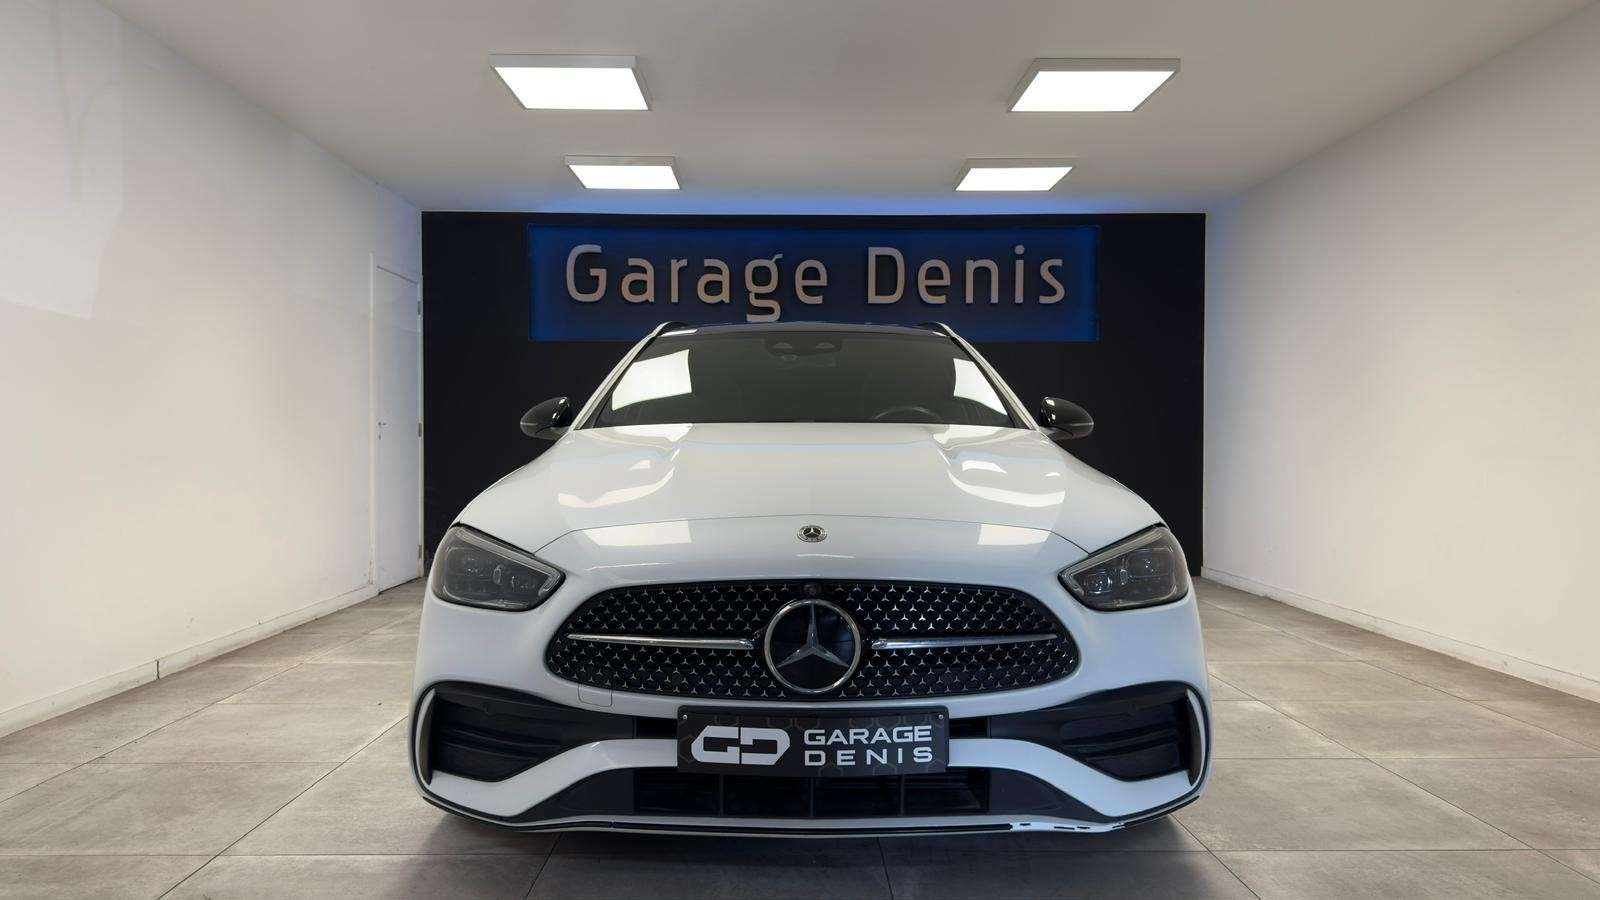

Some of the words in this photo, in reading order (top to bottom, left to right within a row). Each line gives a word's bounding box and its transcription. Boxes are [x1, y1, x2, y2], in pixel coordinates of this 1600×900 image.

[565, 244, 828, 322] Garage
[866, 244, 1067, 305] Denis
[803, 725, 932, 746] GARAGE
[804, 746, 933, 766] DENIS
